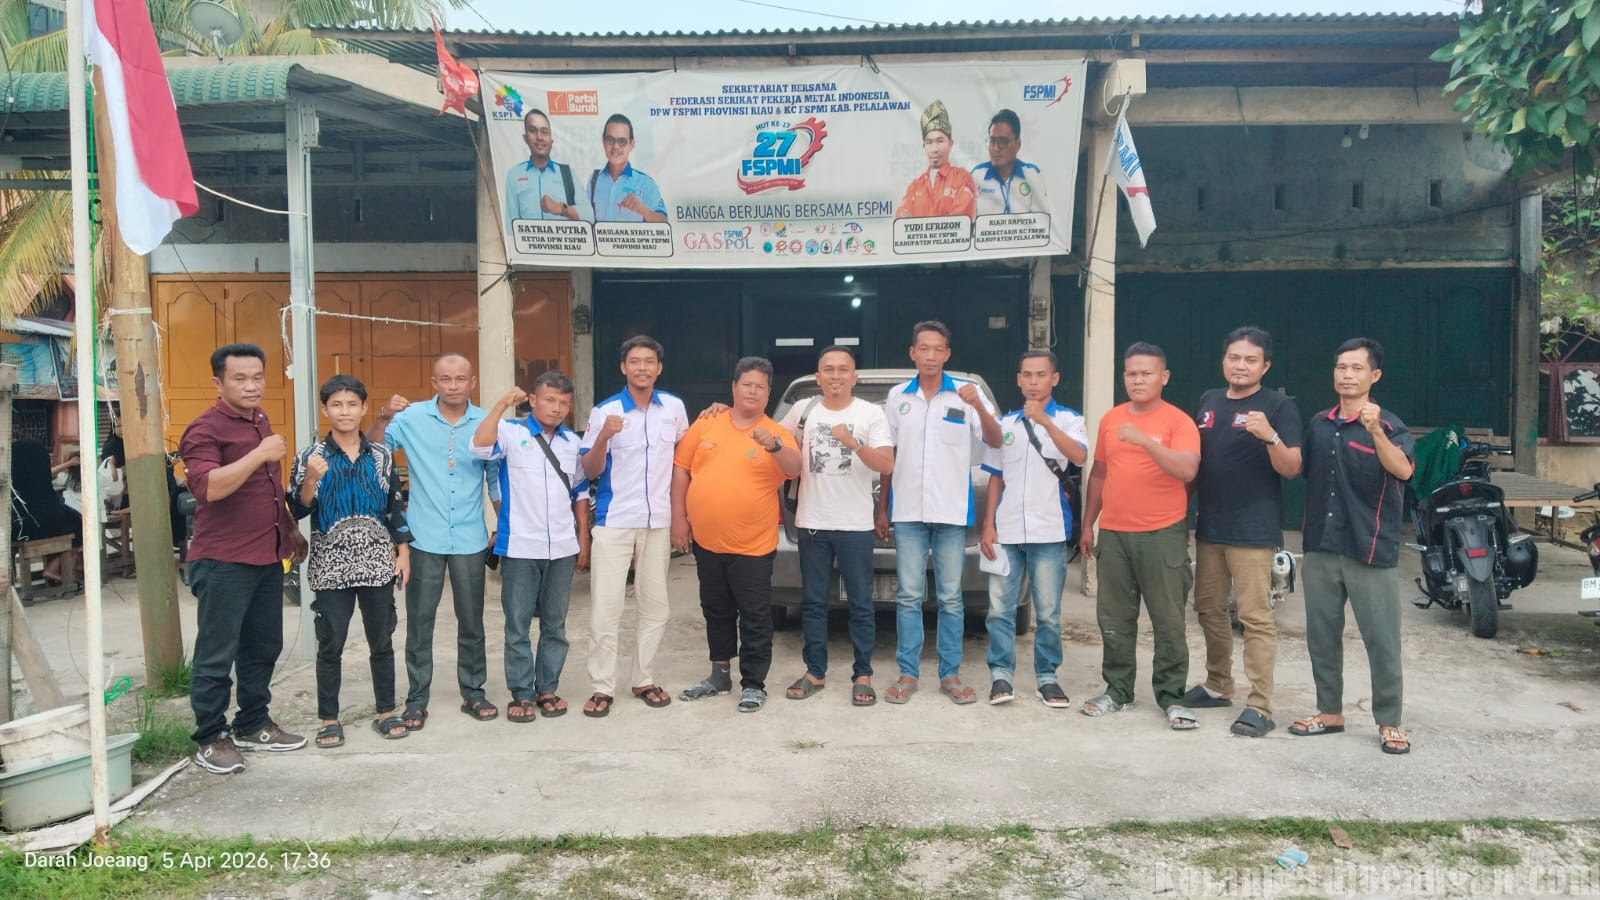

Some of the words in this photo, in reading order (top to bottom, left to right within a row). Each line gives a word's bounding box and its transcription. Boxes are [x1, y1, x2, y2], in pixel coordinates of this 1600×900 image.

[722, 84, 789, 94] SEKRETARIAT
[791, 82, 837, 92] BERSAMA
[1024, 85, 1056, 98] FSPMI
[670, 96, 715, 106] FEDERASI
[717, 96, 759, 105] SERIKAT
[761, 94, 801, 105] PEKERJA
[804, 94, 836, 103] METAL
[838, 91, 890, 101] INDONESIA
[568, 103, 598, 113] Buruh
[650, 108, 671, 116] DPW
[673, 107, 702, 116] FSPMI
[704, 107, 748, 115] PROVINSI
[751, 106, 774, 115] RIAU
[784, 105, 796, 114] KC
[798, 105, 828, 114] FSPMI
[830, 104, 852, 112] KAB.
[853, 102, 911, 111] PELALAWAN
[755, 121, 769, 131] HUT
[753, 131, 797, 158] 27
[741, 158, 801, 176] FSPMI
[676, 205, 725, 219] BANGGA
[729, 204, 791, 219] BERJUANG
[795, 202, 853, 217] BERSAMA
[857, 200, 892, 216] FSPMI
[518, 224, 554, 234] SATRIA
[555, 225, 588, 234] PUTRA
[904, 223, 924, 232] YUDI
[925, 221, 961, 231] EFRIZON
[724, 229, 743, 238] FSPMI
[683, 231, 724, 250] GAS
[725, 238, 754, 250] POL
